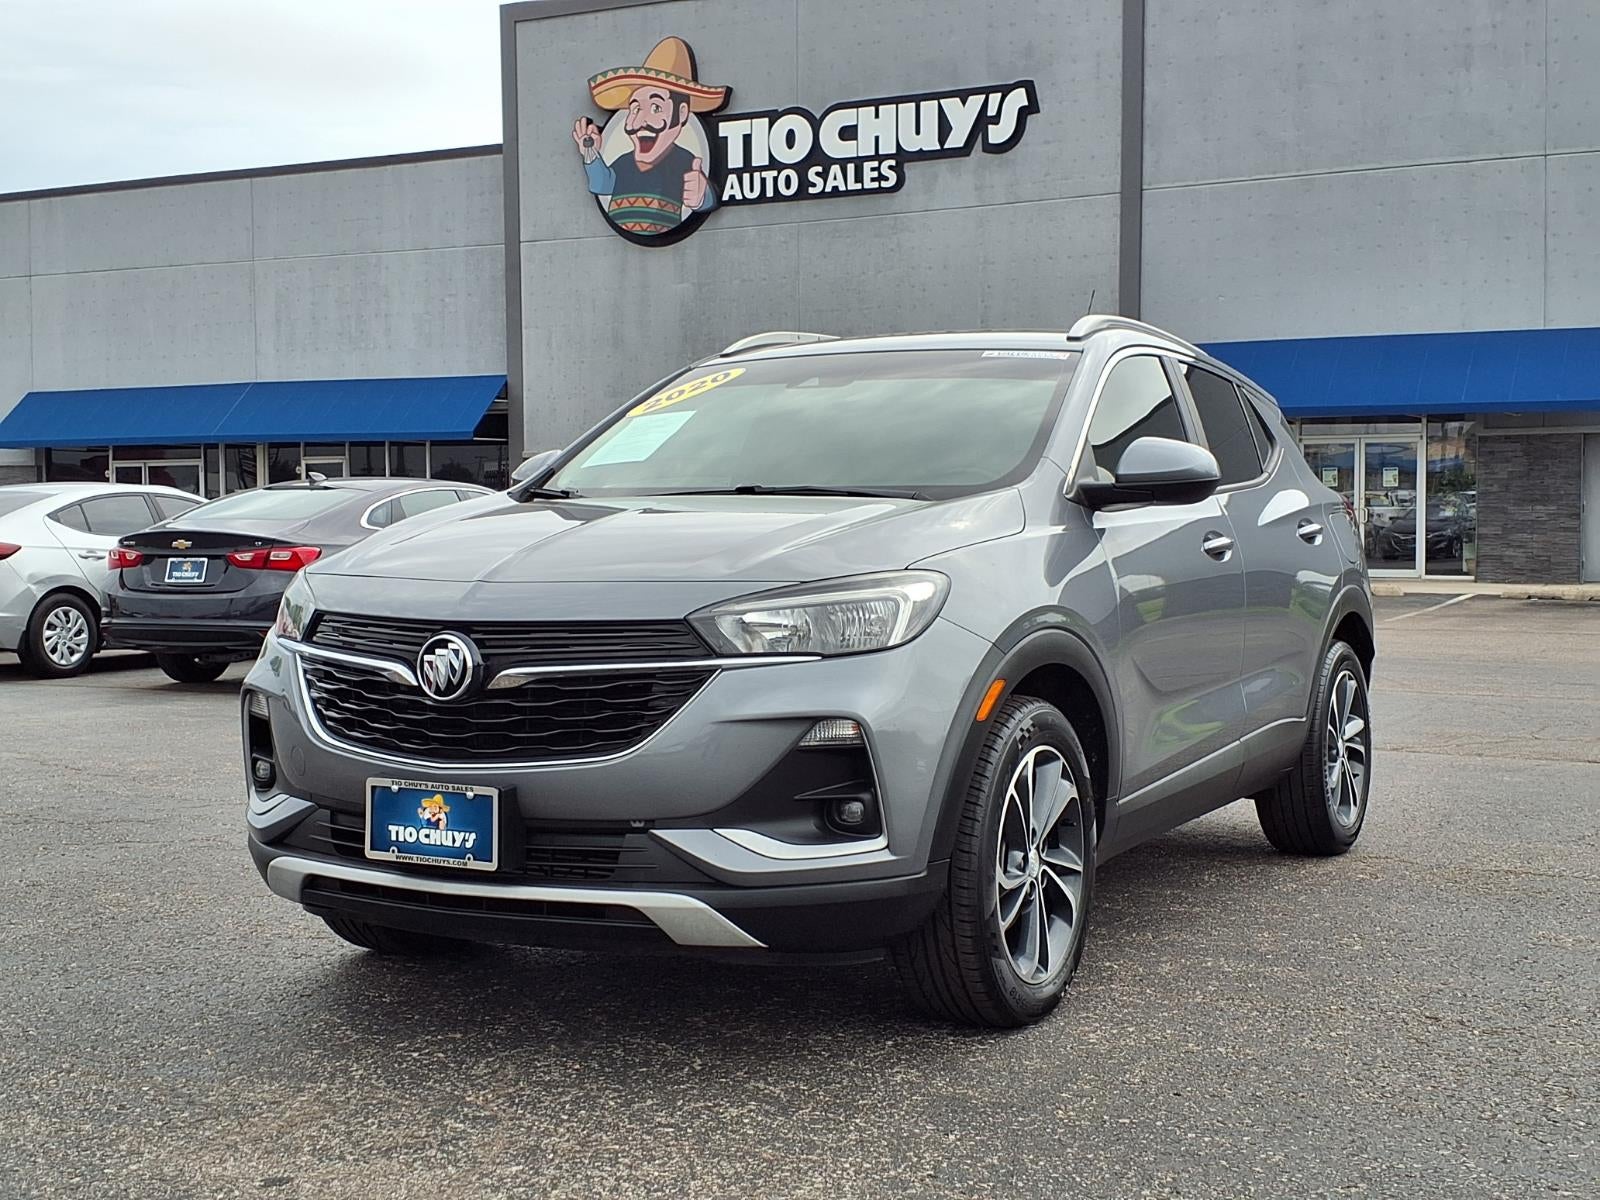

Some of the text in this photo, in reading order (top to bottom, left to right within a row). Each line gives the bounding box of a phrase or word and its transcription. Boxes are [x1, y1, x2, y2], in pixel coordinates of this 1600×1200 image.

[718, 87, 1029, 169] TIO CHUY'S
[721, 160, 897, 201] AUTO SALES
[642, 372, 731, 412] 2020
[404, 781, 429, 789] CHUY'S
[430, 783, 450, 791] AUTO
[388, 825, 477, 849] TIO CHUY'S
[395, 855, 469, 866] WWW.TIOCHUYS.COM
